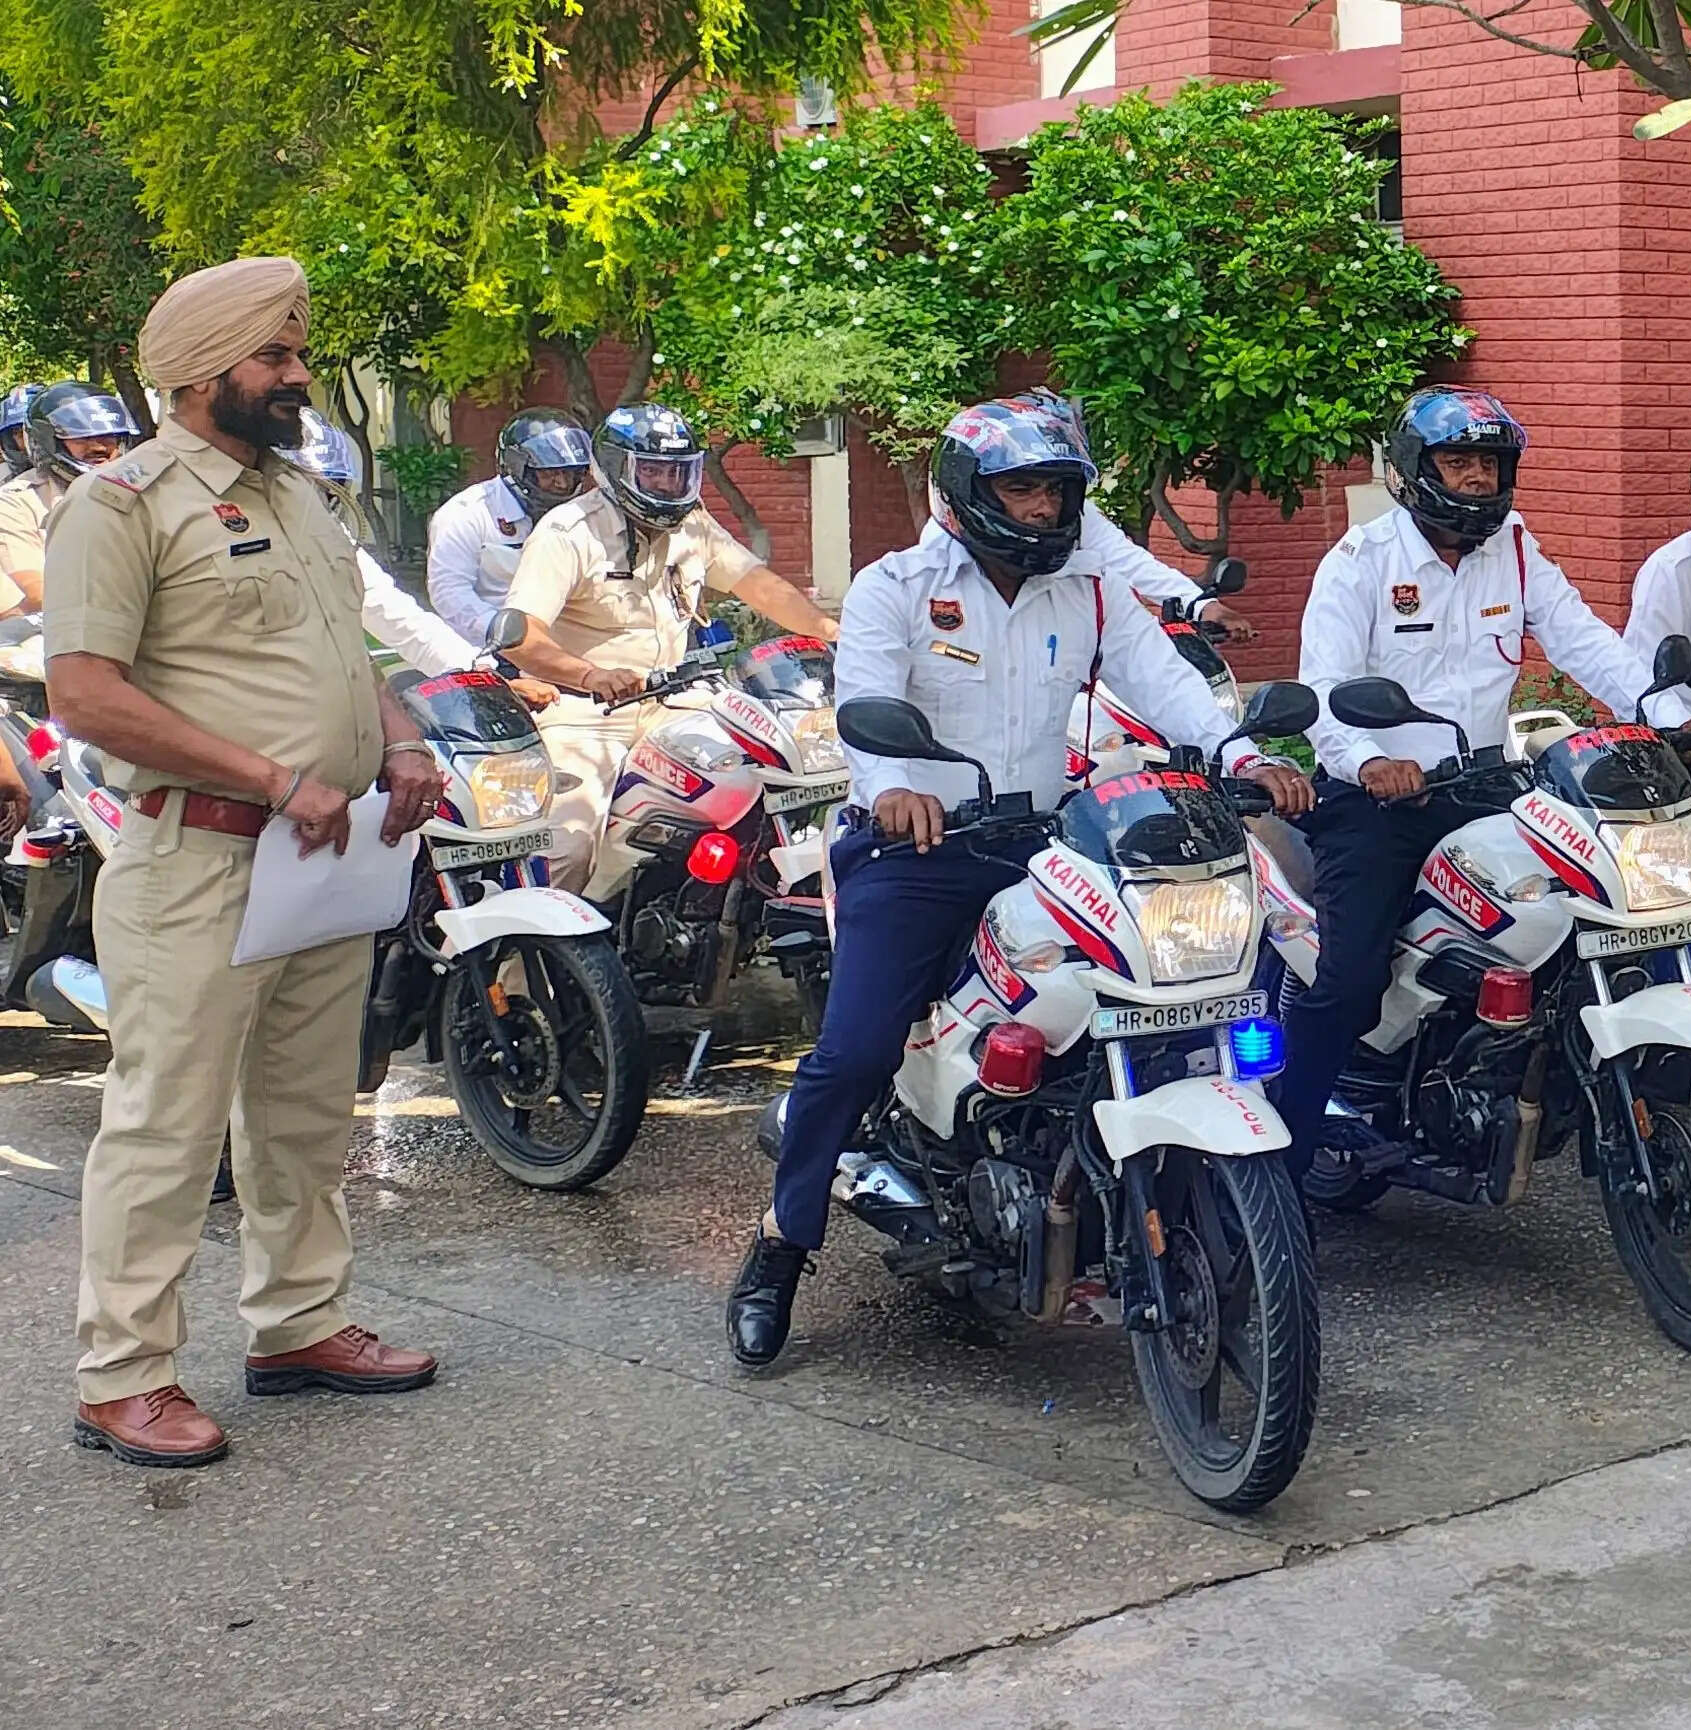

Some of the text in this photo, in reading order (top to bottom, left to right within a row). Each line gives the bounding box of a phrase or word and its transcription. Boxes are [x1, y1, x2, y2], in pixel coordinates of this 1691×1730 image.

[723, 692, 778, 742] KAITHAL
[1093, 771, 1213, 805] RIDER
[1525, 796, 1596, 865] KAITHAL
[1044, 853, 1121, 932] KAITHAL
[1431, 859, 1484, 920] POLICE
[1210, 1081, 1267, 1135] POLICE
